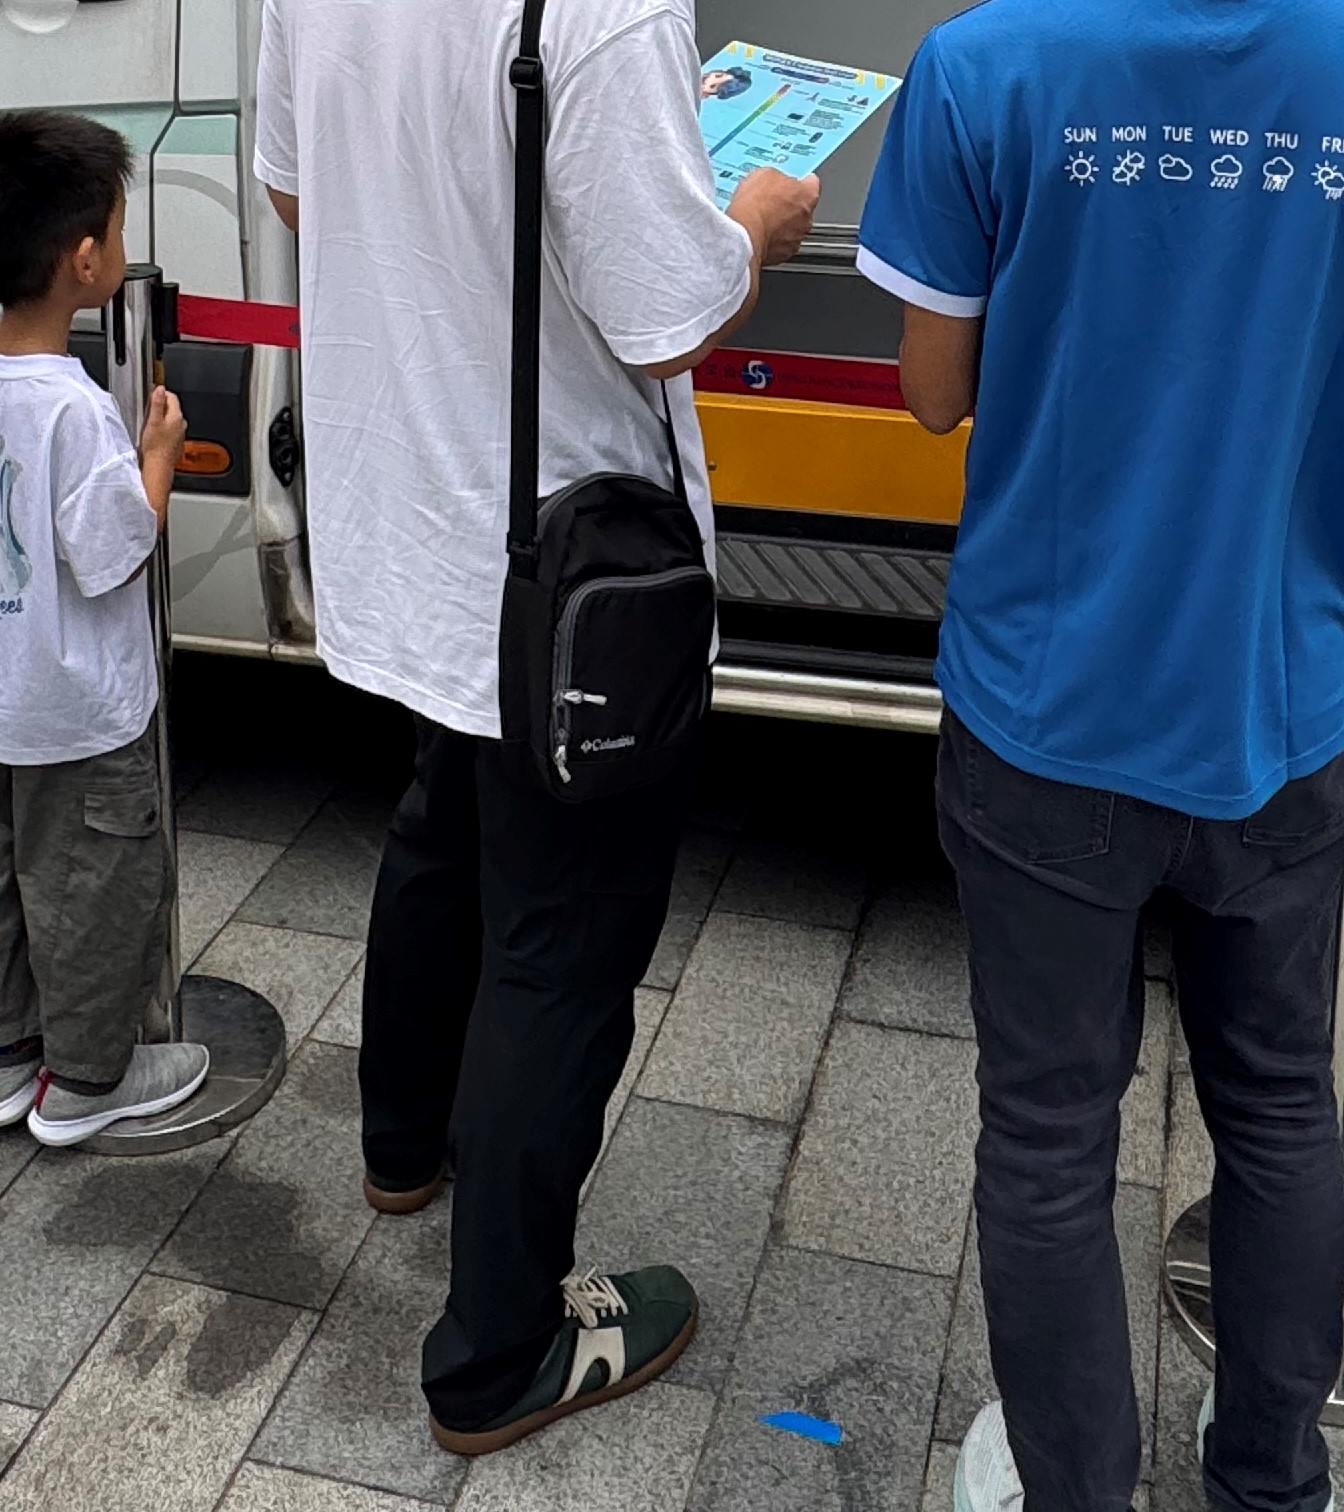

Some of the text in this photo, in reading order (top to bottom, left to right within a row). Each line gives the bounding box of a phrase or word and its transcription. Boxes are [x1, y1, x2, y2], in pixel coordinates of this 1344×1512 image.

[1064, 127, 1097, 143] SUN
[1112, 126, 1147, 142] MON
[1162, 126, 1194, 143] TUE
[1210, 129, 1249, 146] WED
[1264, 132, 1299, 149] THU
